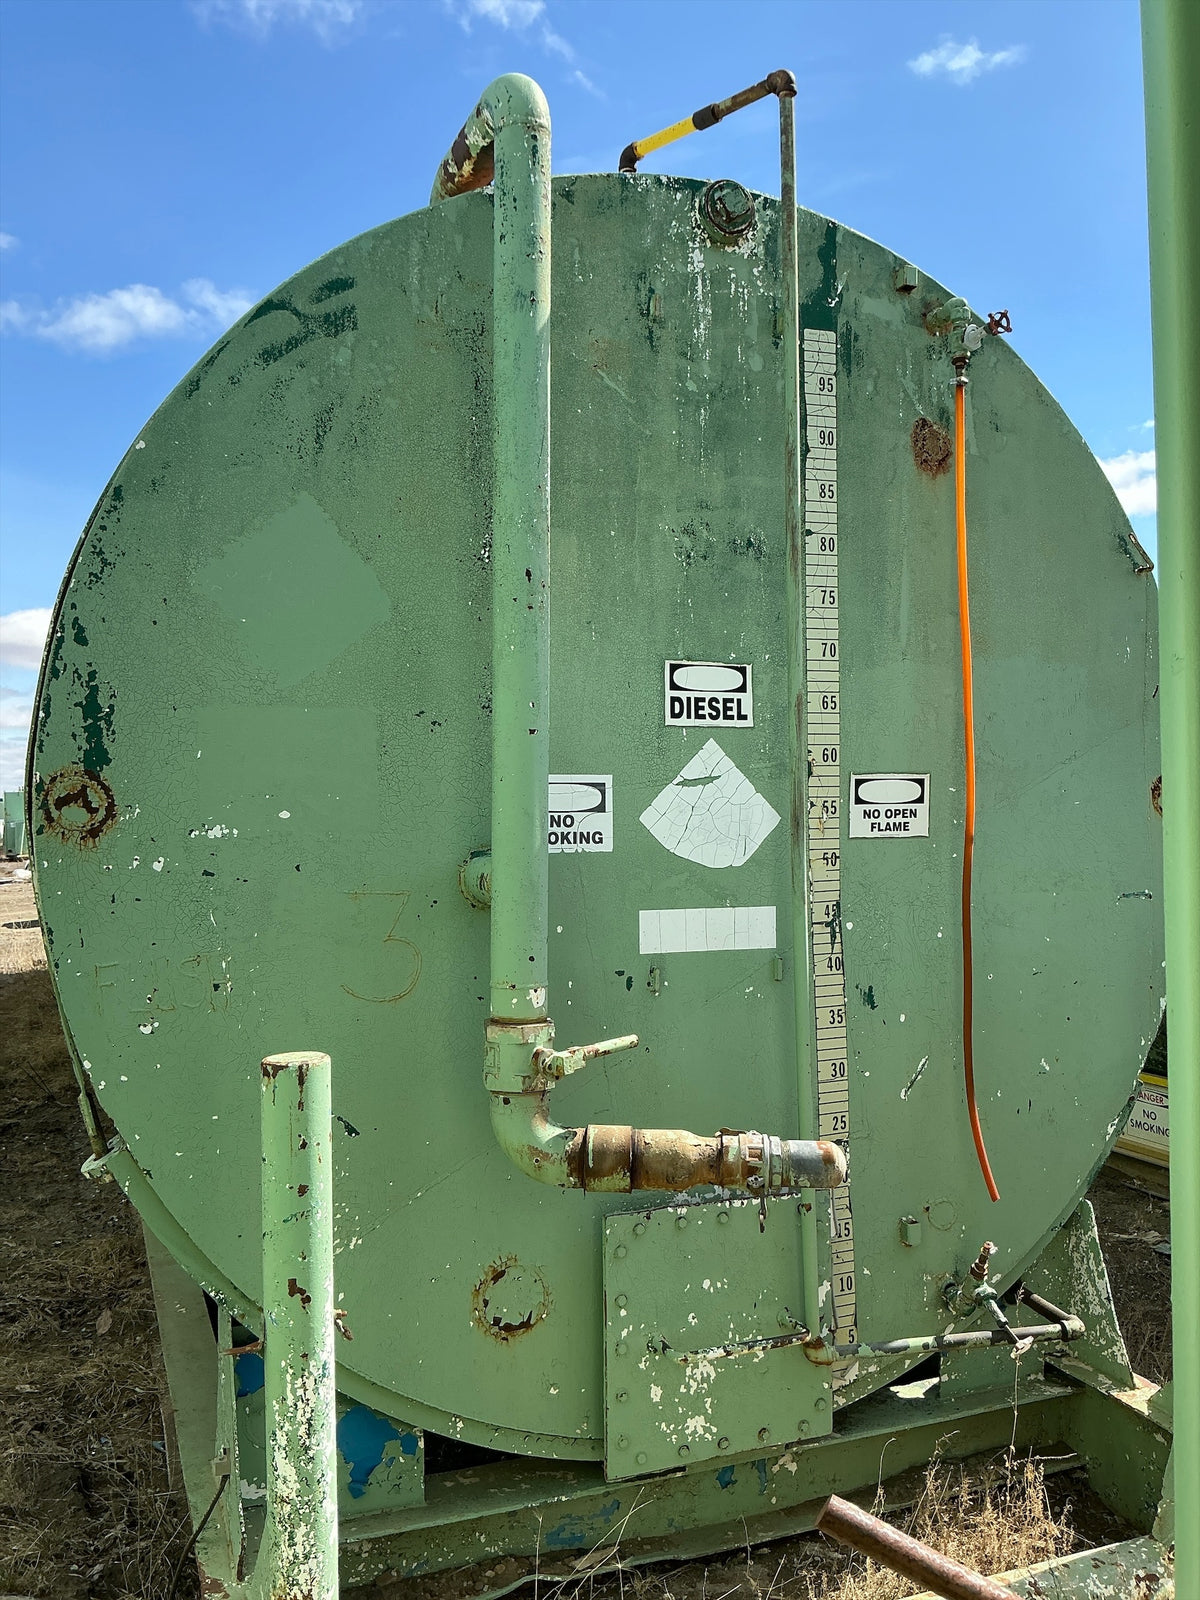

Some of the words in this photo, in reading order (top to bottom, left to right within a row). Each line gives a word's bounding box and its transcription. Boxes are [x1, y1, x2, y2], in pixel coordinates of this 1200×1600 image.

[819, 376, 834, 393] 95
[819, 430, 834, 446] 90
[820, 483, 834, 499] 85
[819, 537, 836, 553] 80
[821, 589, 835, 606] 75
[821, 642, 837, 658] 70
[670, 696, 748, 720] DIESEL
[822, 695, 836, 711] 65
[822, 748, 837, 763] 60
[822, 800, 838, 816] 55
[863, 809, 880, 819] NO
[885, 809, 917, 819] OPEN
[550, 815, 574, 828] NO
[871, 822, 910, 832] FLAME
[548, 831, 603, 845] OKING
[822, 852, 838, 868] 50
[826, 957, 842, 971] 40
[829, 1009, 845, 1026] 35
[831, 1061, 847, 1078] 30
[1137, 1091, 1164, 1104] ANGER
[1142, 1109, 1157, 1120] NO
[832, 1115, 848, 1131] 25
[1130, 1119, 1170, 1137] SMOKING
[837, 1222, 852, 1238] 15
[838, 1275, 854, 1291] 10
[848, 1329, 855, 1344] 5
